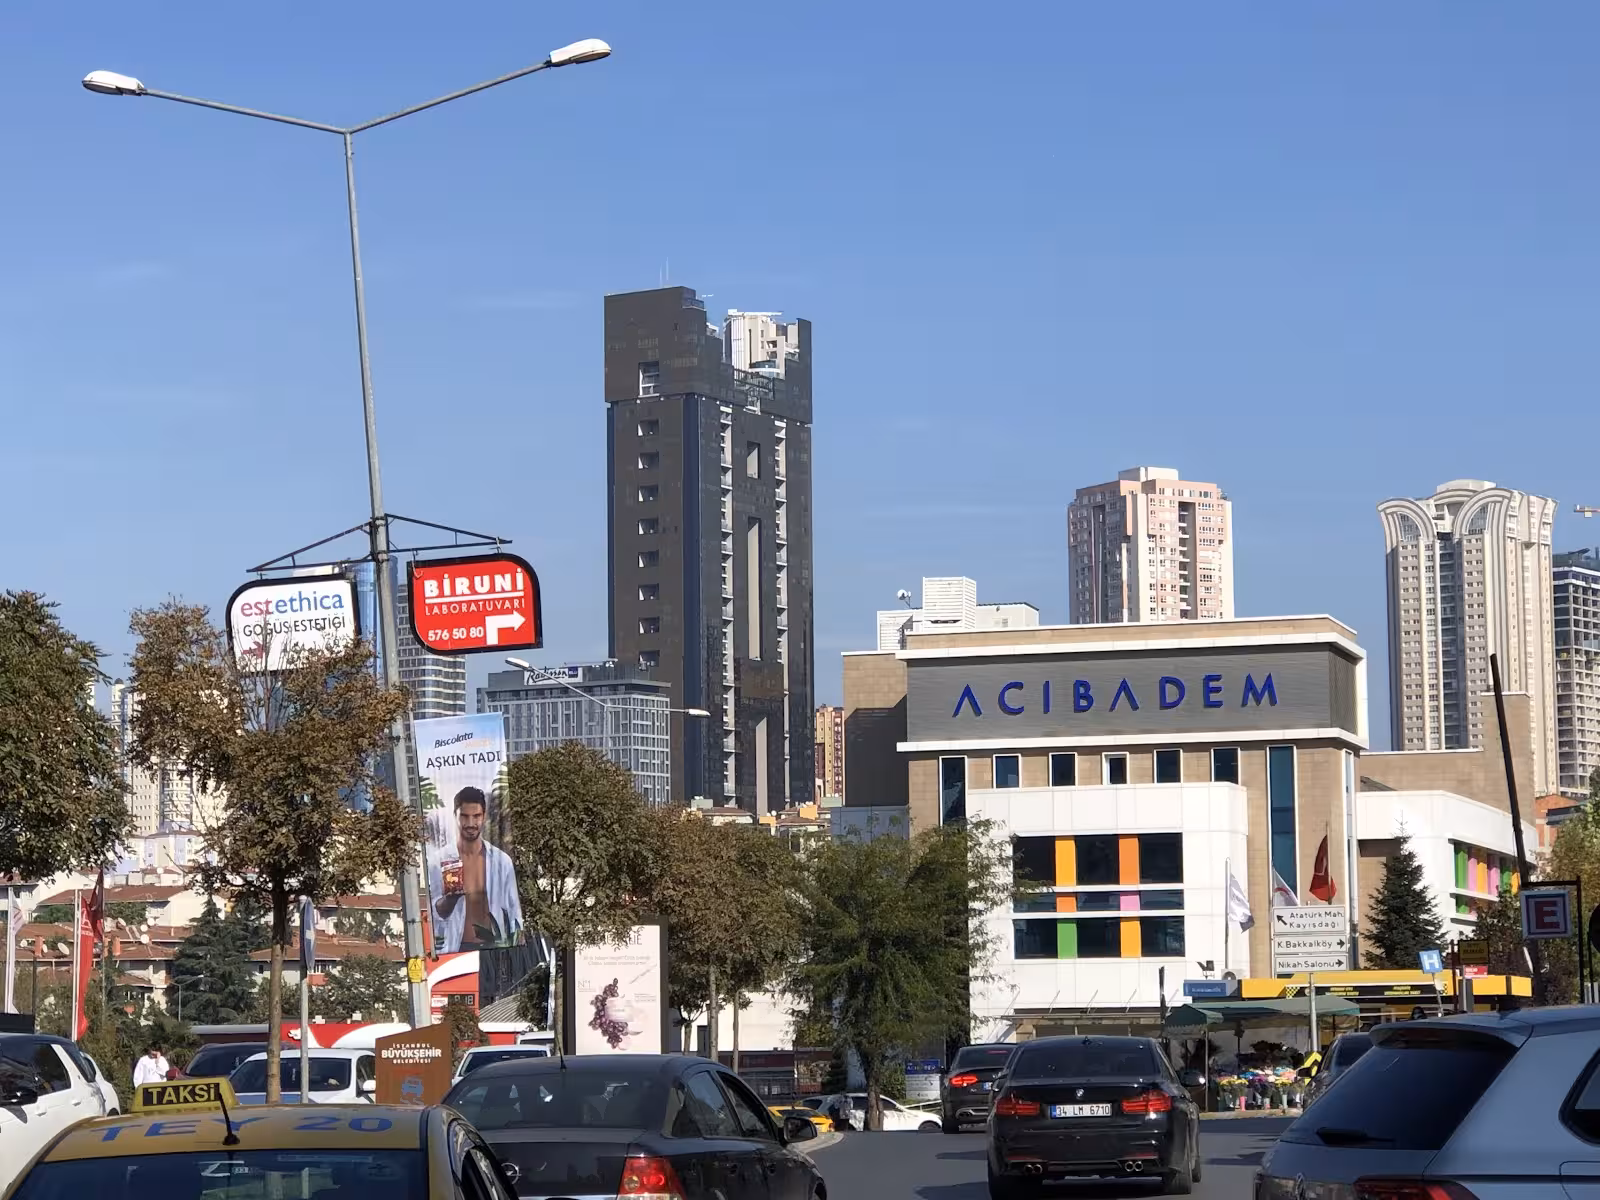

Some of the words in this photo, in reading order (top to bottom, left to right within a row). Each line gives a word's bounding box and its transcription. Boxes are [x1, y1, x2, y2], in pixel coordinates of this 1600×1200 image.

[424, 568, 524, 597] BİRUNİ
[241, 591, 344, 616] estethica
[425, 598, 525, 615] LABORATUVARI
[427, 629, 450, 642] 576
[452, 627, 466, 640] 50
[469, 626, 484, 638] 80
[951, 672, 1278, 718] ACIBADEM
[434, 731, 474, 749] Biscolata
[426, 753, 465, 770] AŞKIN
[468, 750, 501, 764] TADI
[1534, 900, 1560, 929] E
[1423, 953, 1440, 970] H
[381, 1046, 442, 1060] BÜYÜKŞEHİR
[1056, 1106, 1067, 1117] 34
[1089, 1105, 1110, 1115] 6710
[91, 1116, 273, 1143] TEY
[293, 1116, 393, 1133] 20
